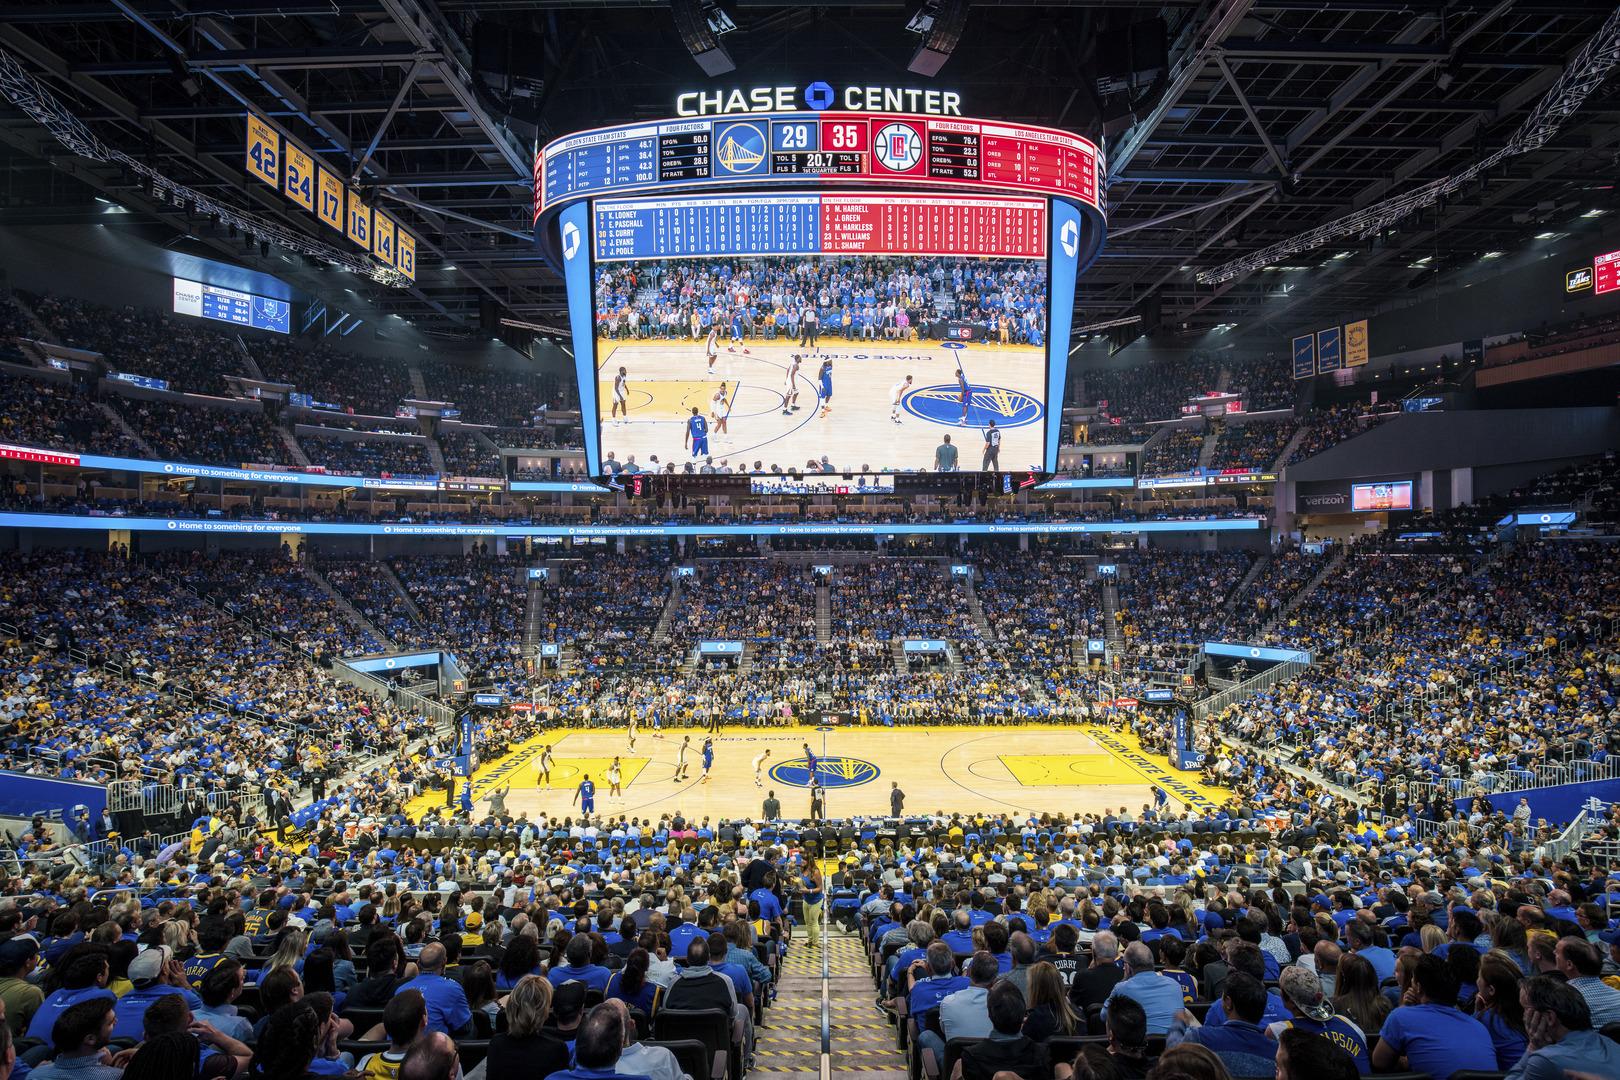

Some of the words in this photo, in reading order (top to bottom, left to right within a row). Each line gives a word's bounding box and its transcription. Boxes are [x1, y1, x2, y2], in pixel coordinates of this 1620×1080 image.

[677, 87, 797, 116] CHASE
[844, 86, 962, 116] CENTER
[680, 122, 704, 131] FACTORS
[566, 138, 582, 148] GOLDEN
[582, 136, 596, 144] STATE
[597, 134, 611, 142] TEAM
[612, 132, 626, 140] STATS
[694, 135, 708, 144] 50.0
[782, 126, 808, 148] 29
[832, 126, 858, 148] 35
[964, 137, 976, 145] 79.4
[1025, 131, 1046, 140] ANGELES
[807, 154, 833, 166] 20.7
[964, 148, 977, 156] 22.3
[250, 142, 276, 180] 42
[288, 164, 311, 203] 24
[636, 172, 652, 182] 100.0
[323, 190, 338, 222] 17
[352, 211, 366, 241] 16
[378, 230, 391, 259] 14
[401, 246, 413, 273] 13
[210, 470, 250, 480] something
[264, 474, 298, 483] everyone
[1306, 496, 1344, 506] verizon
[213, 523, 252, 533] something
[1088, 729, 1133, 753] GOLDEN
[1124, 754, 1166, 774] STATE
[474, 744, 544, 788] FRANCISCO
[1054, 960, 1077, 970] CURRY
